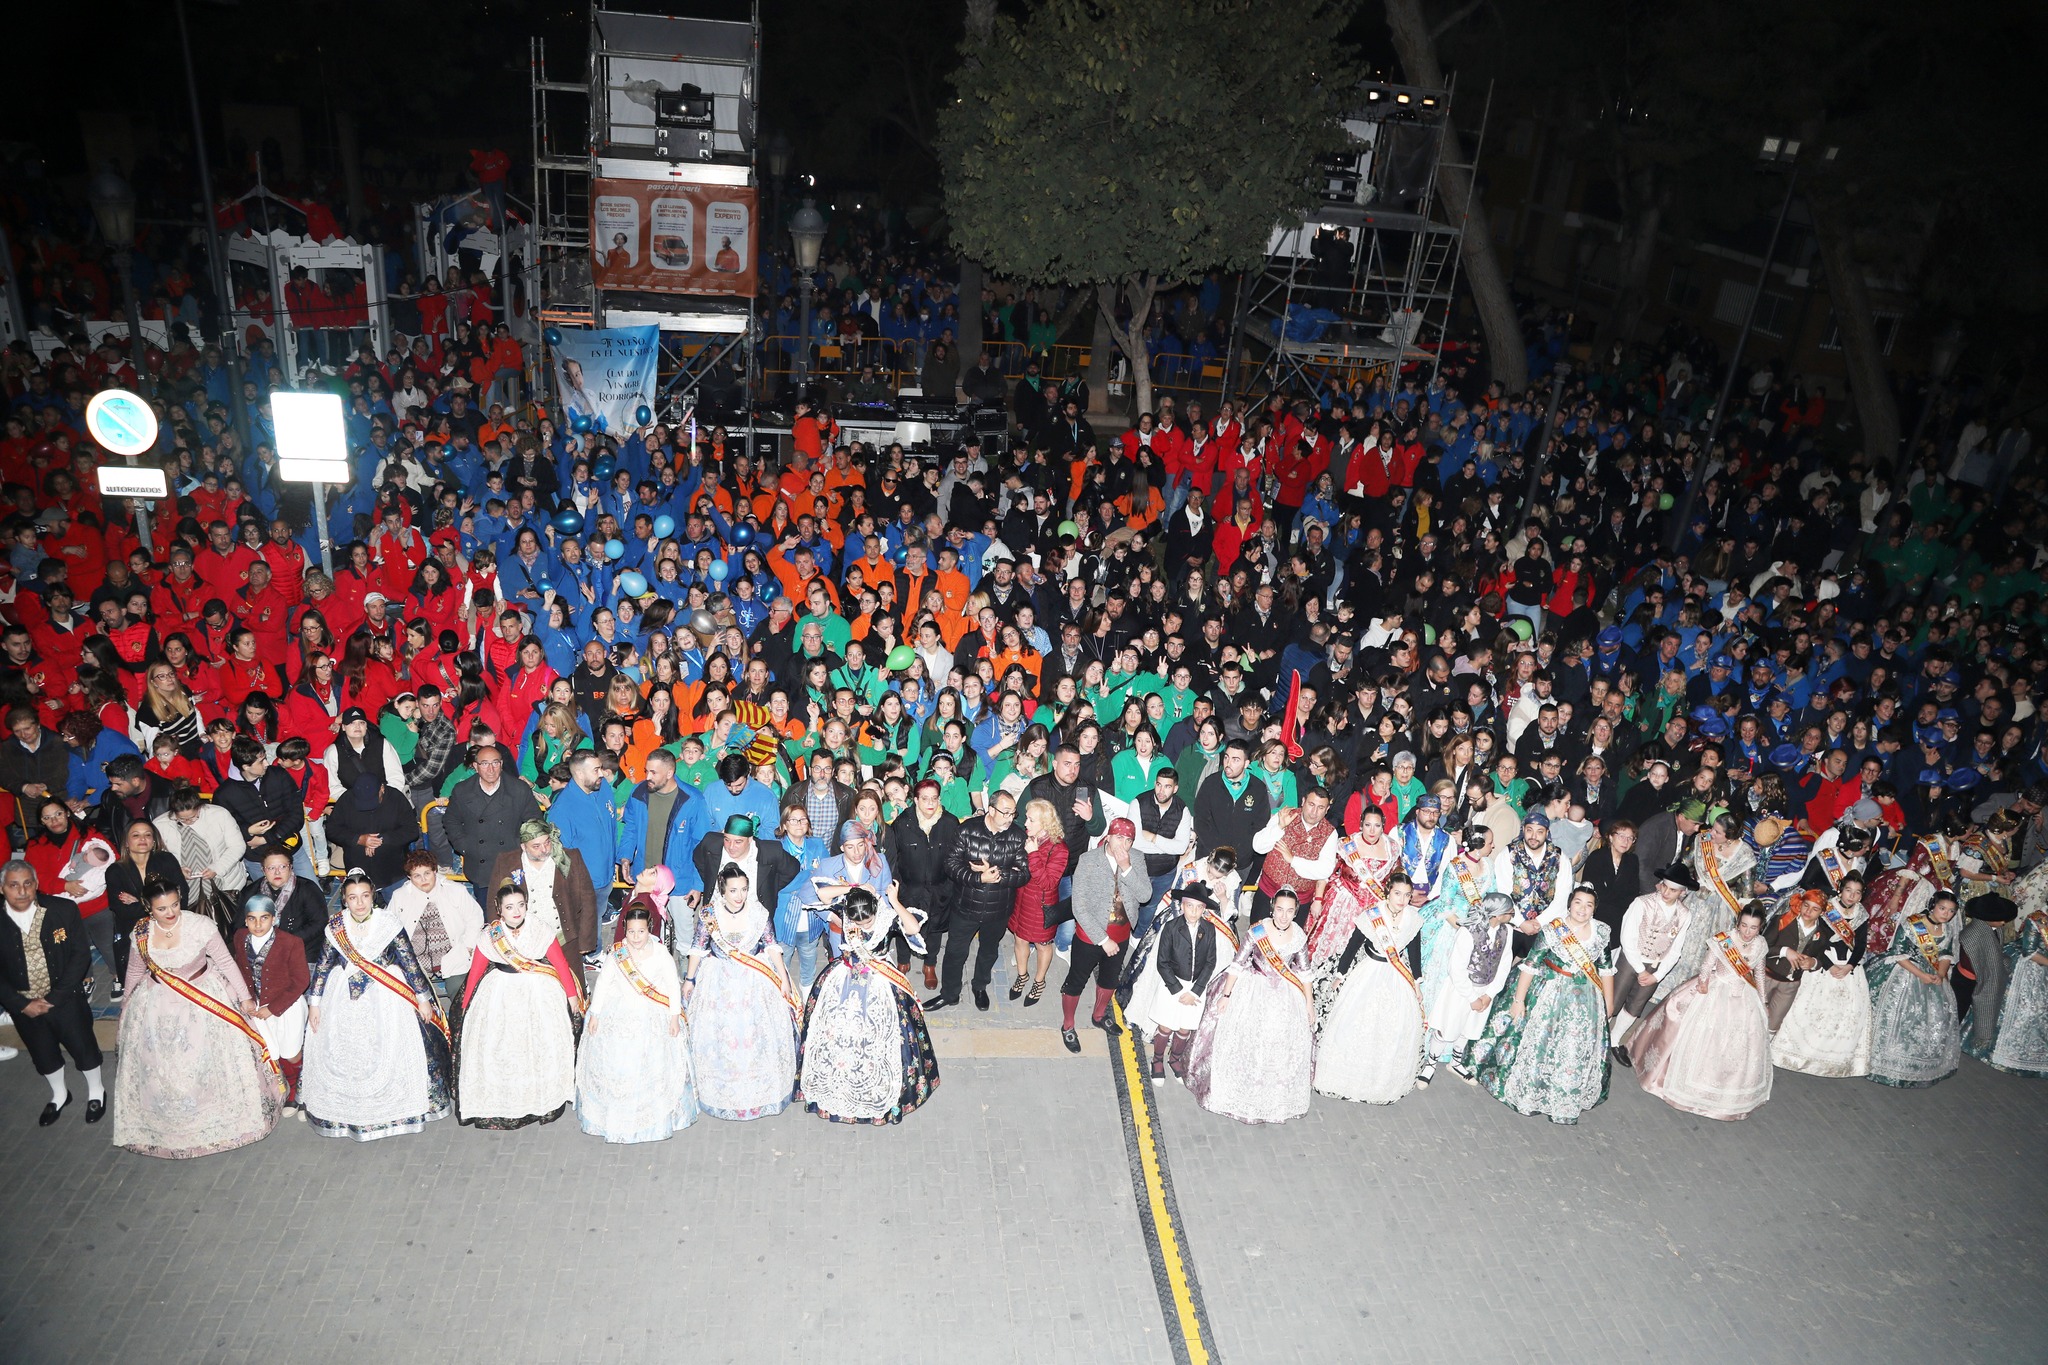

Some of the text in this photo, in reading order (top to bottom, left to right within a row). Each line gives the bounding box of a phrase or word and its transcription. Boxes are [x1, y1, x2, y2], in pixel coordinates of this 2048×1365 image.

[714, 212, 741, 220] EXPERTO
[605, 379, 640, 389] VINAGRE
[105, 486, 163, 494] AUTORIZADOS
